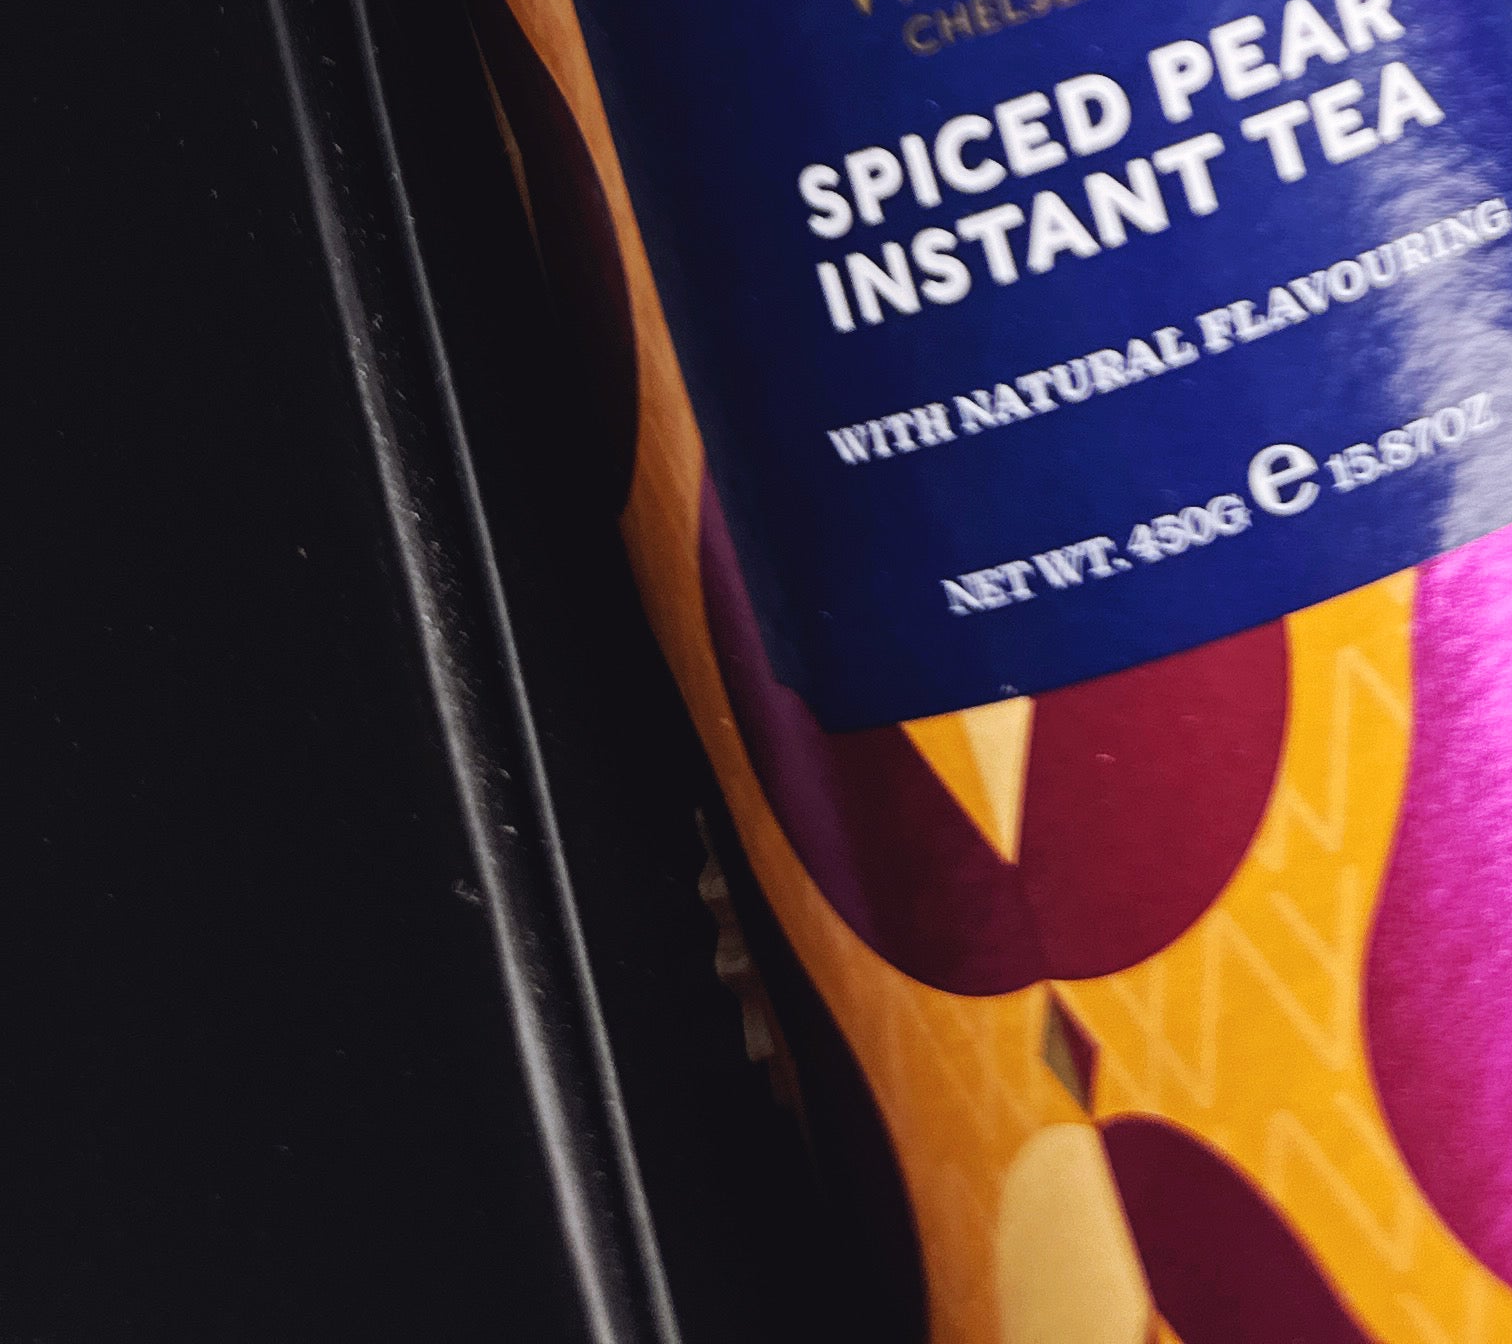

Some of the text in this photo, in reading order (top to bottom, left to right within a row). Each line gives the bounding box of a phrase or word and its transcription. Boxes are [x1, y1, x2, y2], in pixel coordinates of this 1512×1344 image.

[799, 73, 1132, 239] SPICED
[815, 60, 1446, 332] INSTANT TEA
[826, 401, 957, 466] WITH
[953, 326, 1199, 435] NATURAL
[940, 560, 1038, 616] NET
[1029, 535, 1133, 592] WT.
[1126, 493, 1253, 564] 450G
